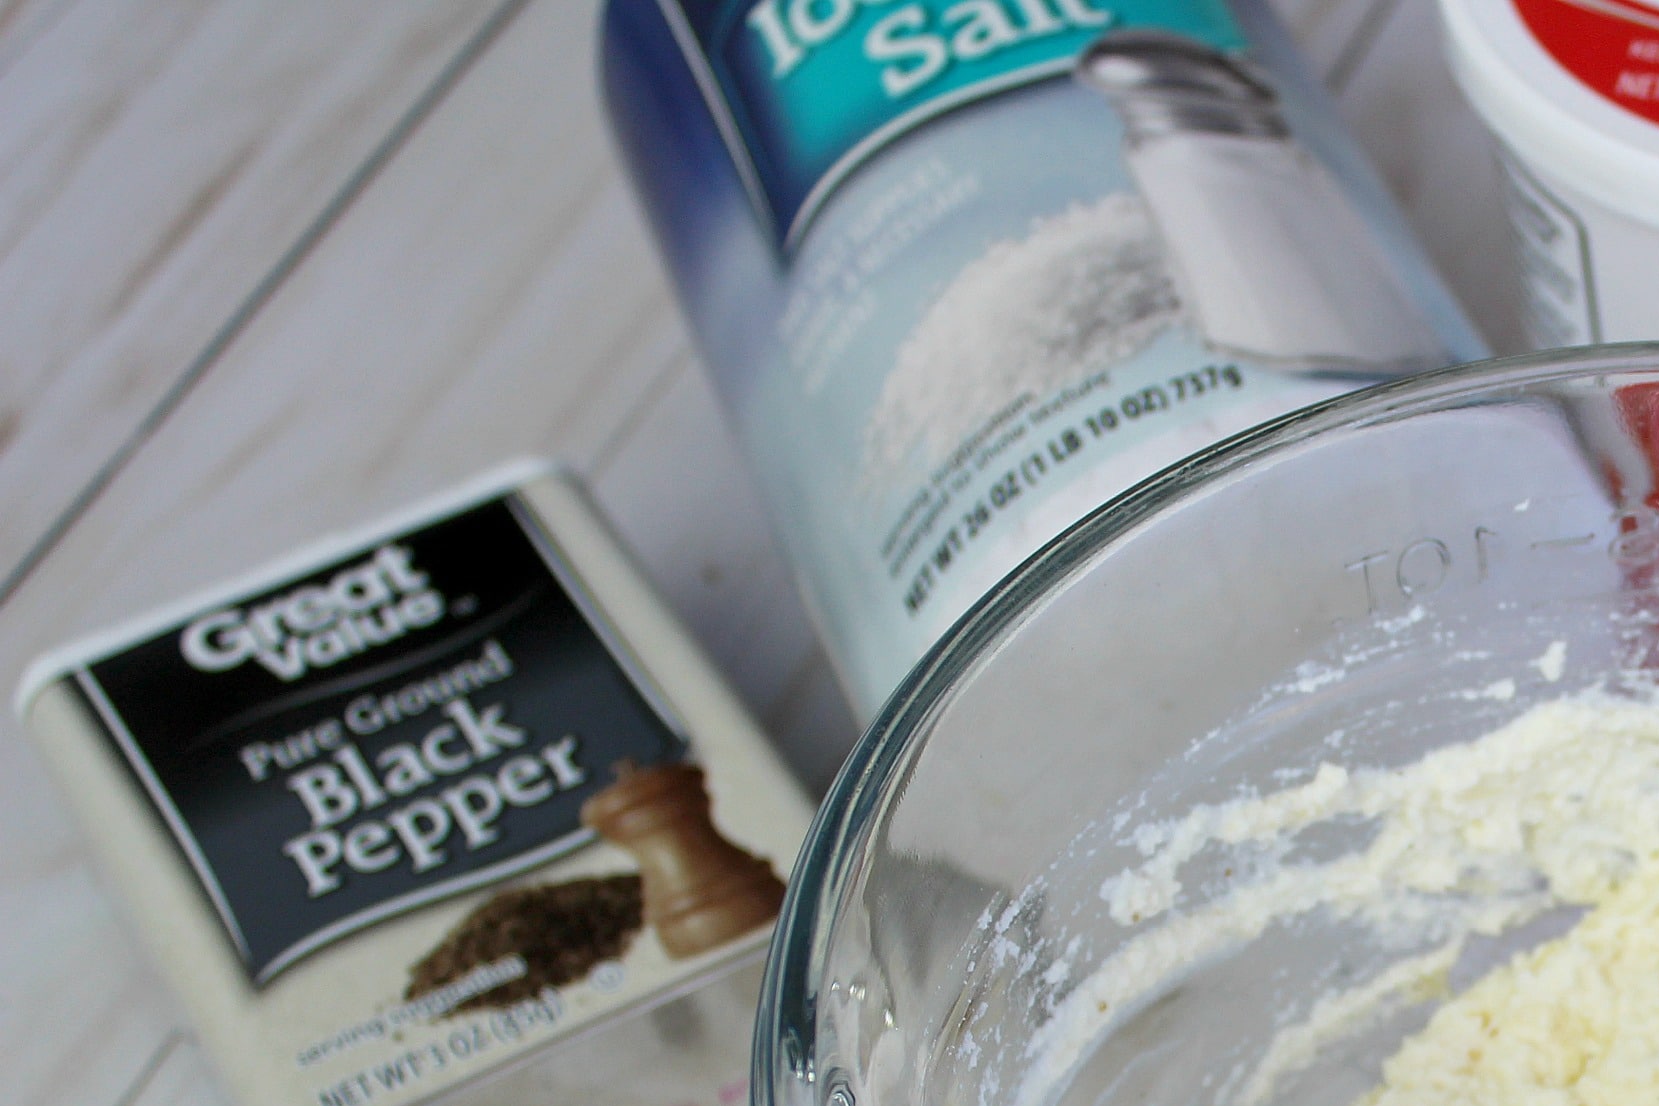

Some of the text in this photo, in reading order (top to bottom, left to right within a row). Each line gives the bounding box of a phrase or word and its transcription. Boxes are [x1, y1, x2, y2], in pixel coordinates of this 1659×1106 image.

[904, 563, 937, 614] NET
[931, 526, 966, 573] WT
[989, 469, 1024, 511] OZ
[1046, 426, 1085, 465] LB
[1085, 406, 1120, 440] 10
[1120, 384, 1171, 421] OZ)
[181, 545, 428, 672] Great
[257, 588, 446, 682] Value
[240, 638, 514, 781] Pure Ground
[286, 698, 528, 830] Black
[284, 738, 585, 896] Pepper
[295, 1016, 385, 1069] serving
[373, 1050, 423, 1092] WT
[429, 1043, 449, 1069] 3
[448, 1022, 490, 1060] OZ
